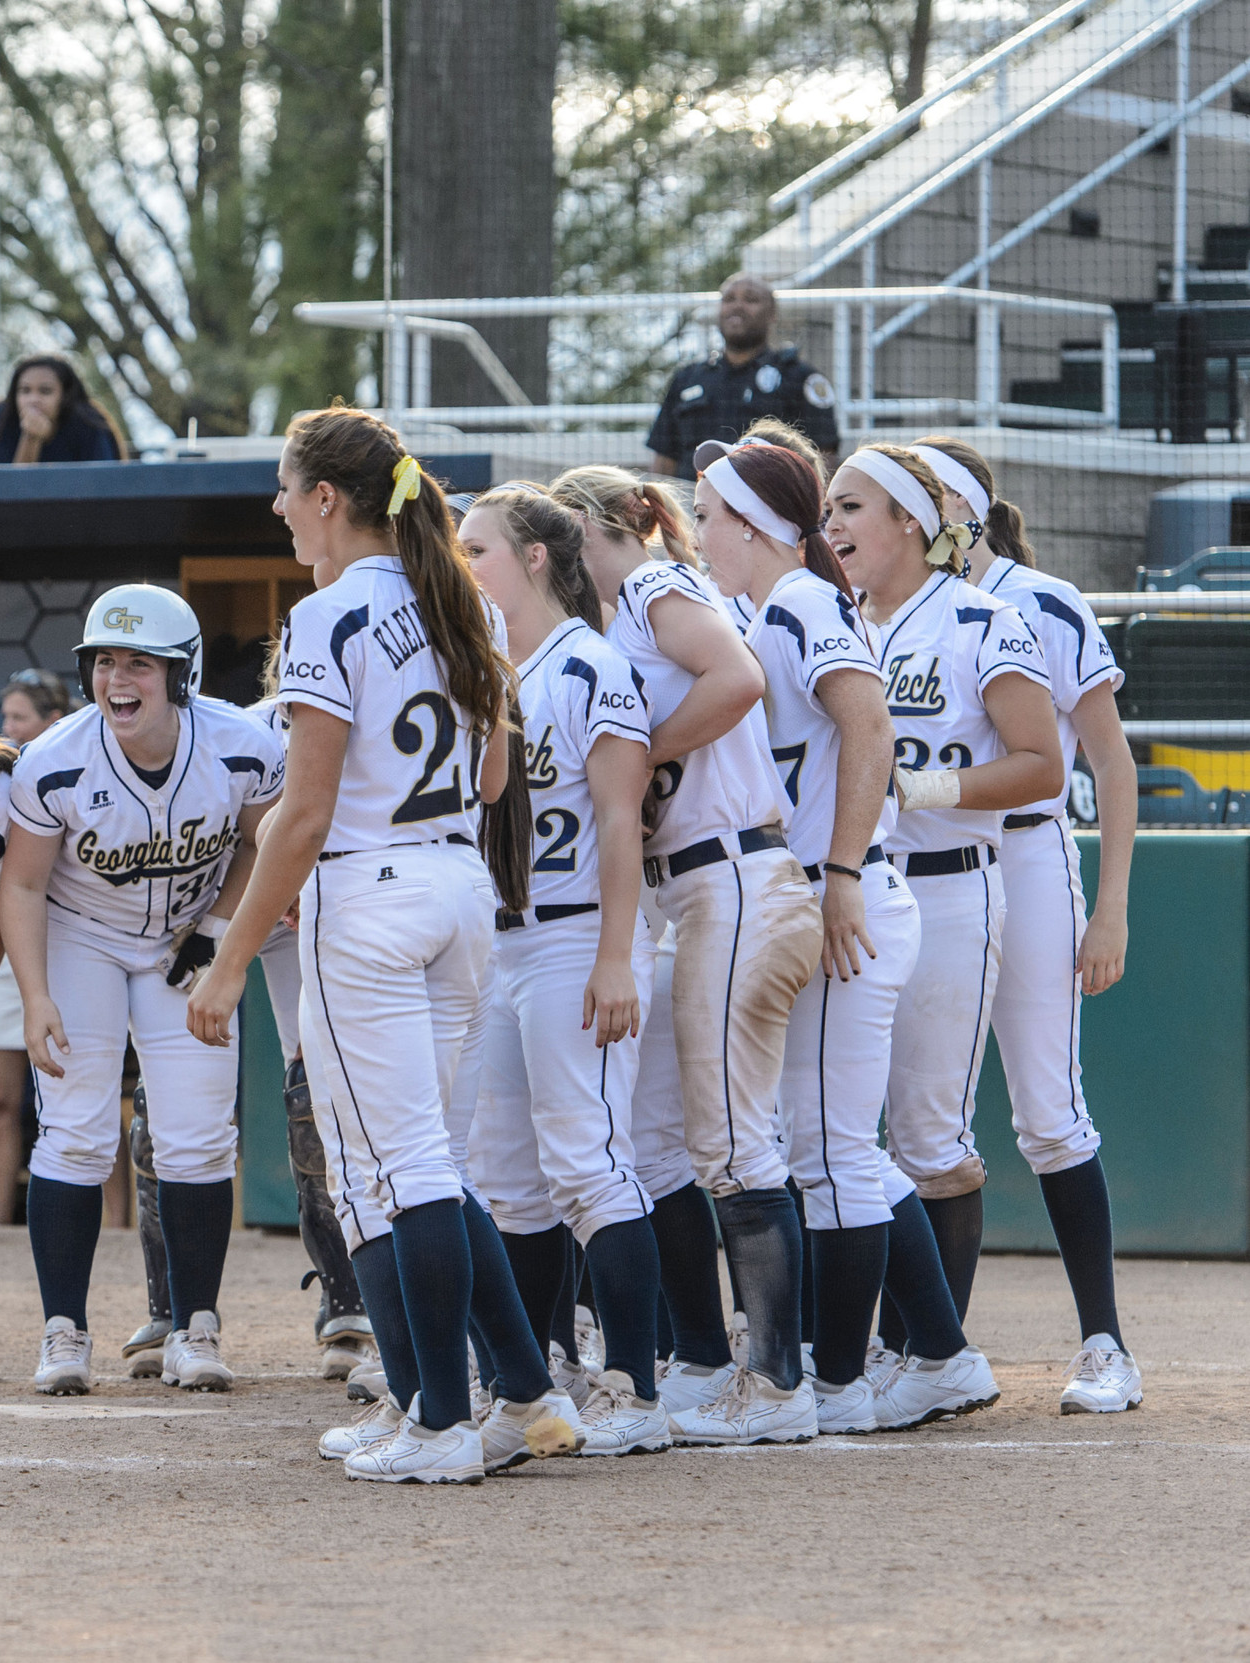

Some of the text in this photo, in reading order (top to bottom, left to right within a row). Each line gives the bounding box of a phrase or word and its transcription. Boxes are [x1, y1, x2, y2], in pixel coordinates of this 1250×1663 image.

[633, 569, 671, 596] ACC
[102, 606, 143, 634] GT
[812, 637, 852, 657] ACC
[998, 638, 1033, 655] ACC
[284, 662, 327, 681] ACC
[885, 652, 947, 706] Tech
[598, 691, 636, 711] ACC
[76, 814, 231, 886] Georgia Tech
